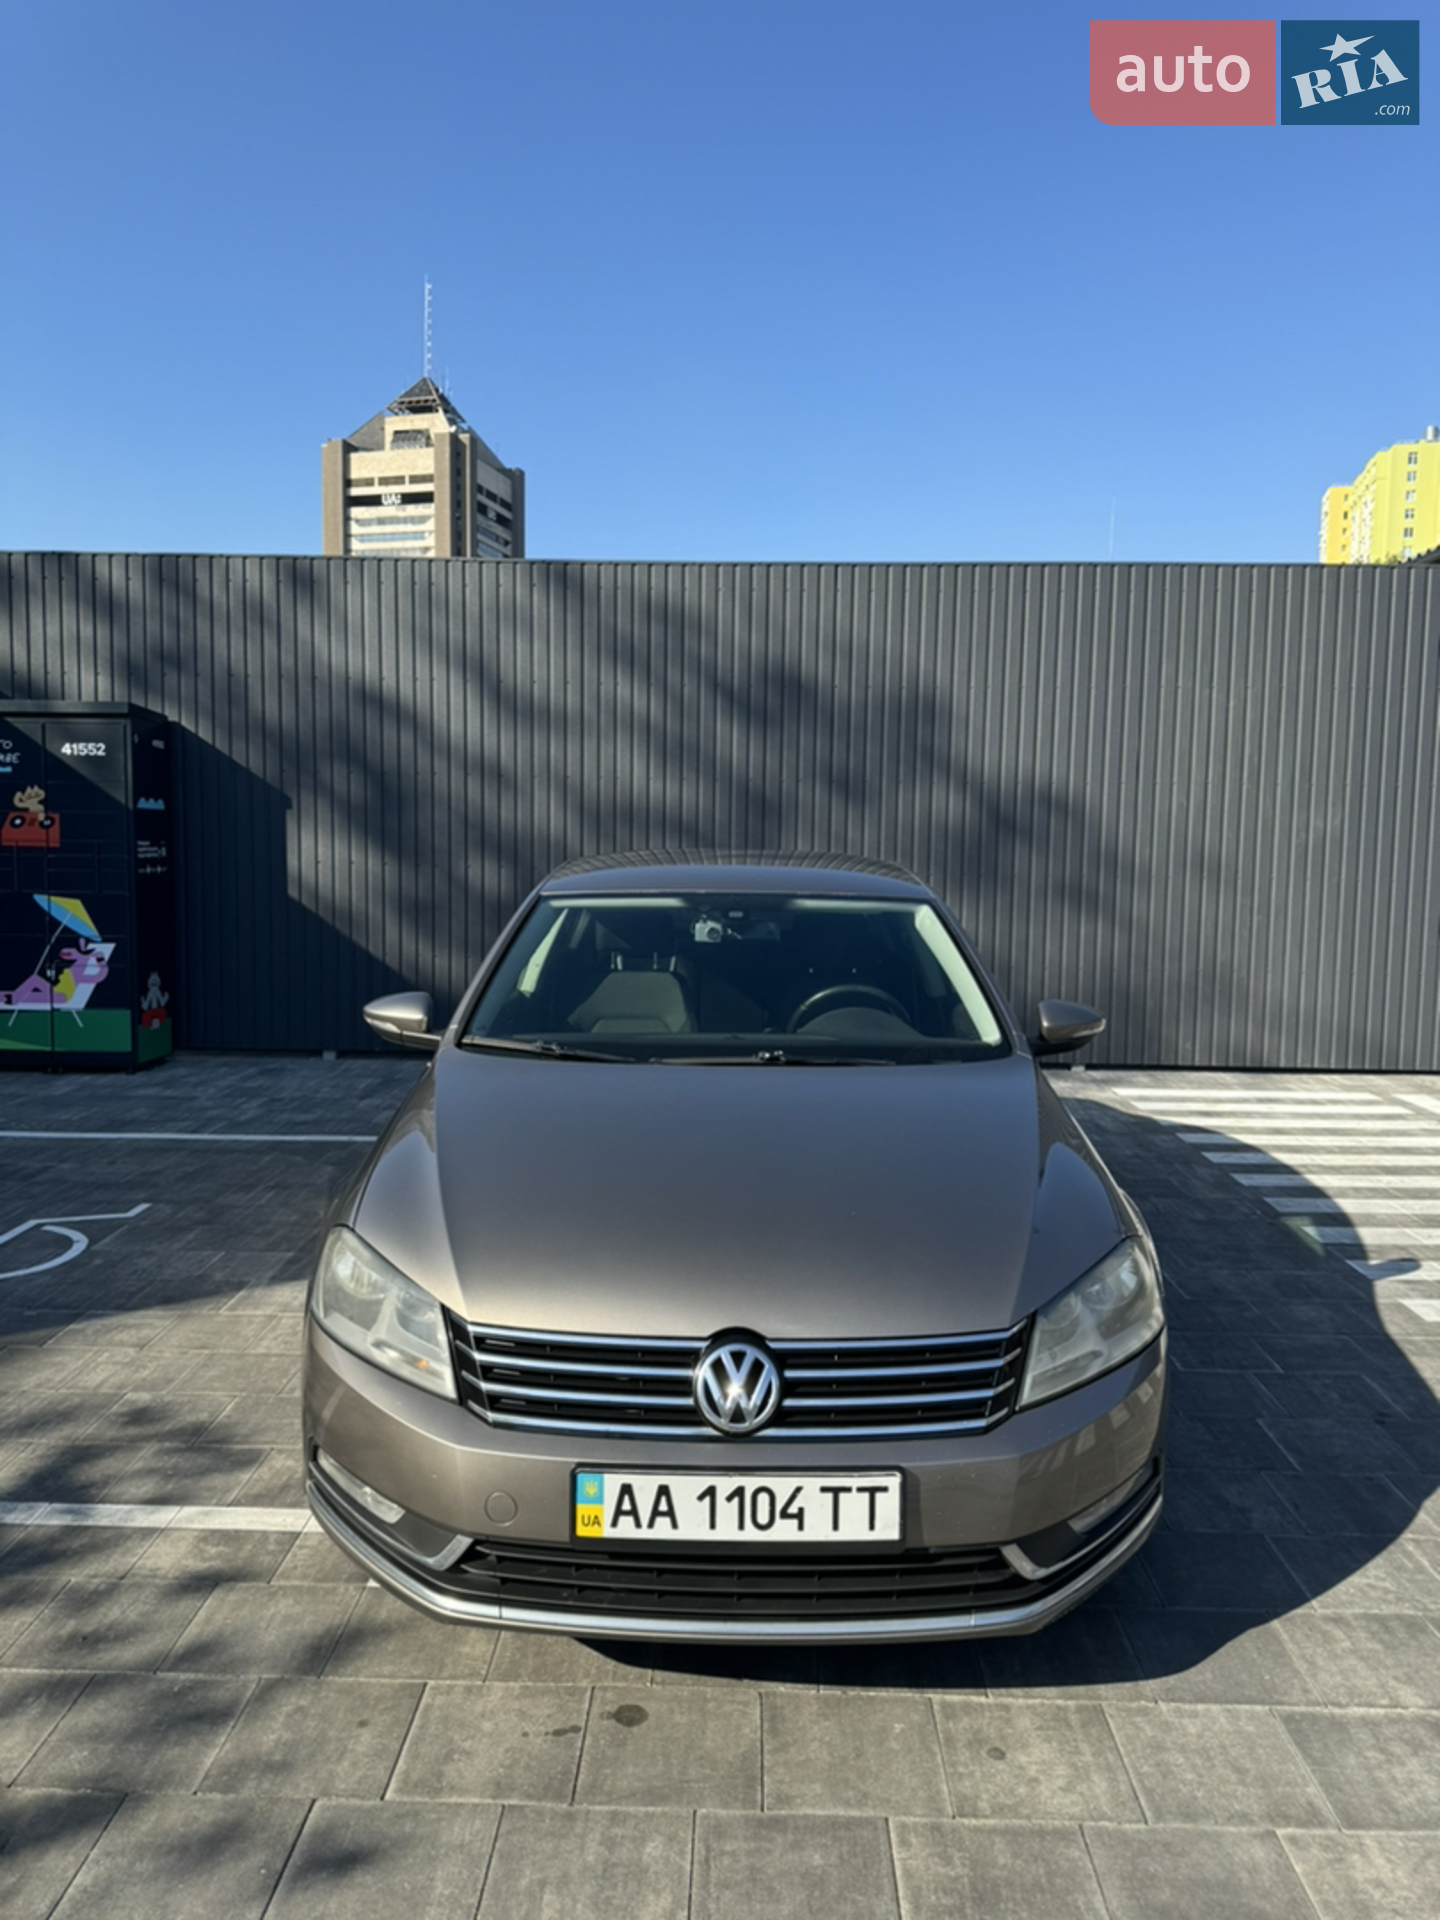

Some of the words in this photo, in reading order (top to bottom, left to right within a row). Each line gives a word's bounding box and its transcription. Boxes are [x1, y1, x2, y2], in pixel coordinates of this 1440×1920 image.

[61, 742, 106, 756] 41552
[610, 1483, 679, 1530] AA
[696, 1485, 805, 1532] 1104
[819, 1486, 889, 1532] TT
[581, 1514, 602, 1528] UA
